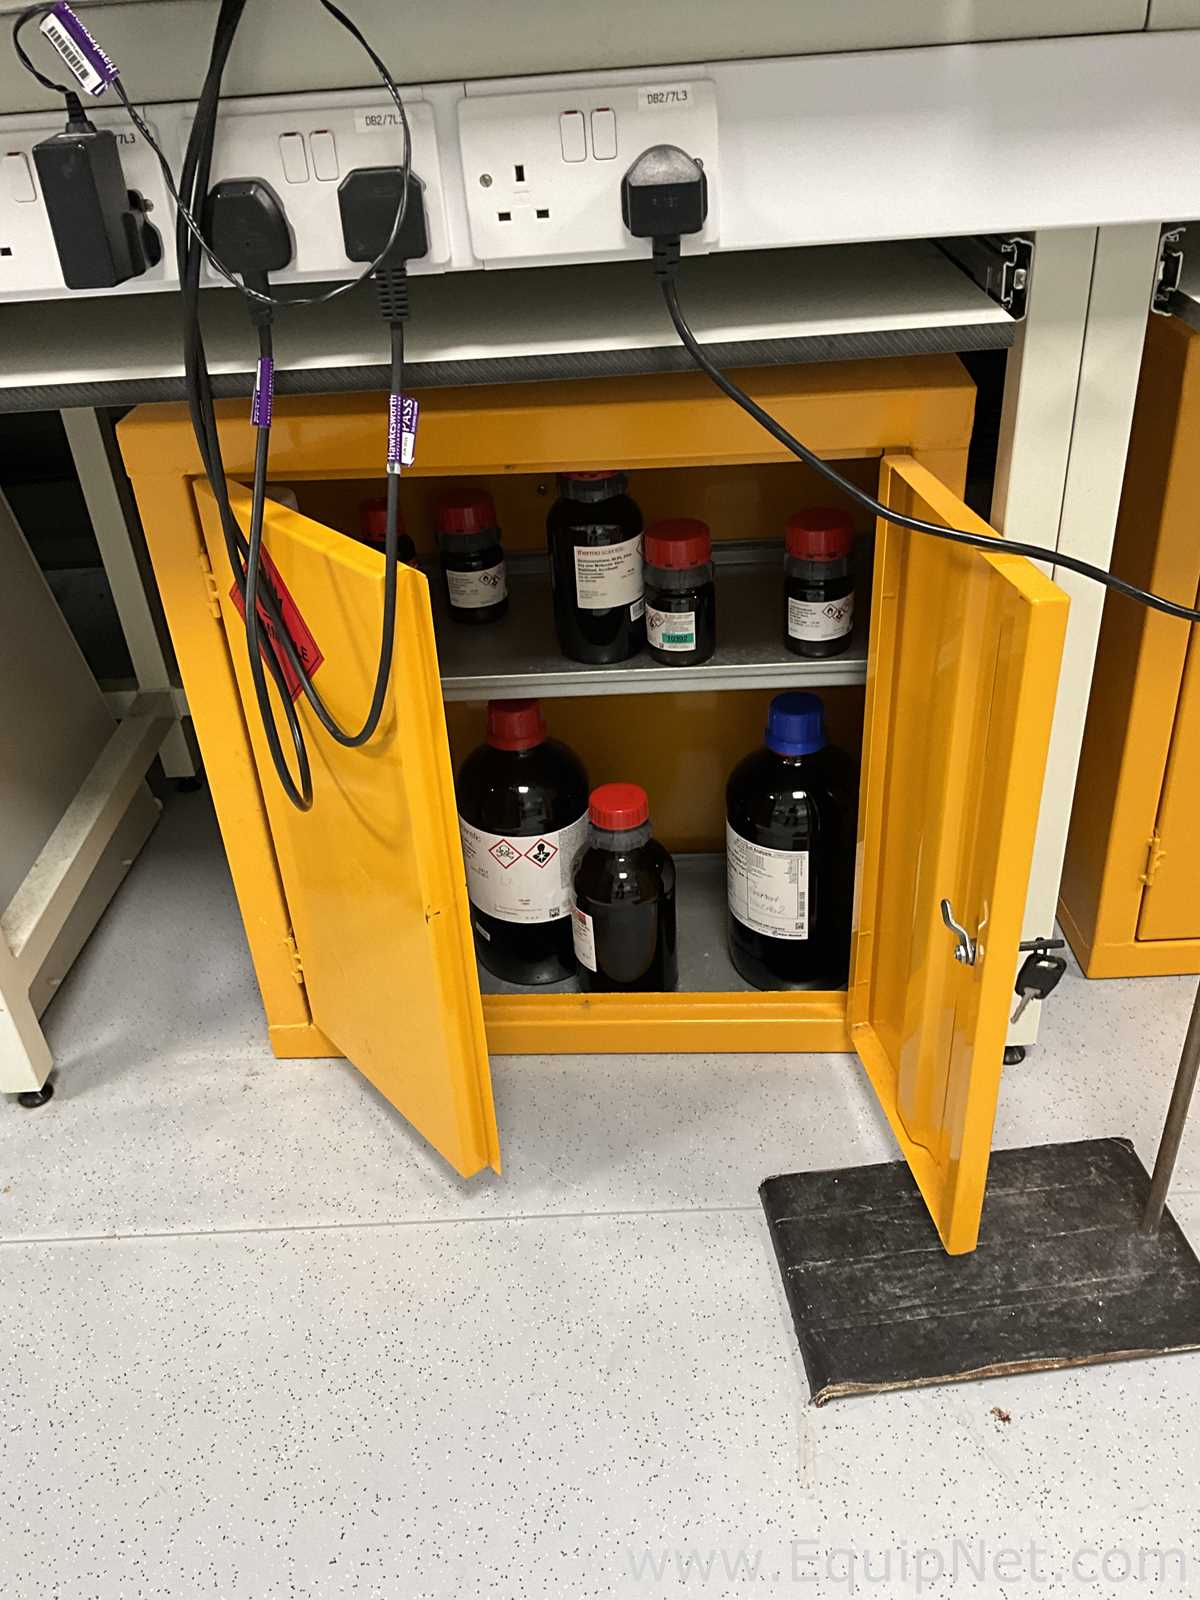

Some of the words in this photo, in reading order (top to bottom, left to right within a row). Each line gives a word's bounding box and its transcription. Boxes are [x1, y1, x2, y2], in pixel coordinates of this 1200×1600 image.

[647, 90, 688, 105] DB2/7L3
[365, 114, 404, 126] DB2/7L
[388, 394, 397, 460] Hawkesworth
[402, 399, 413, 432] PASS
